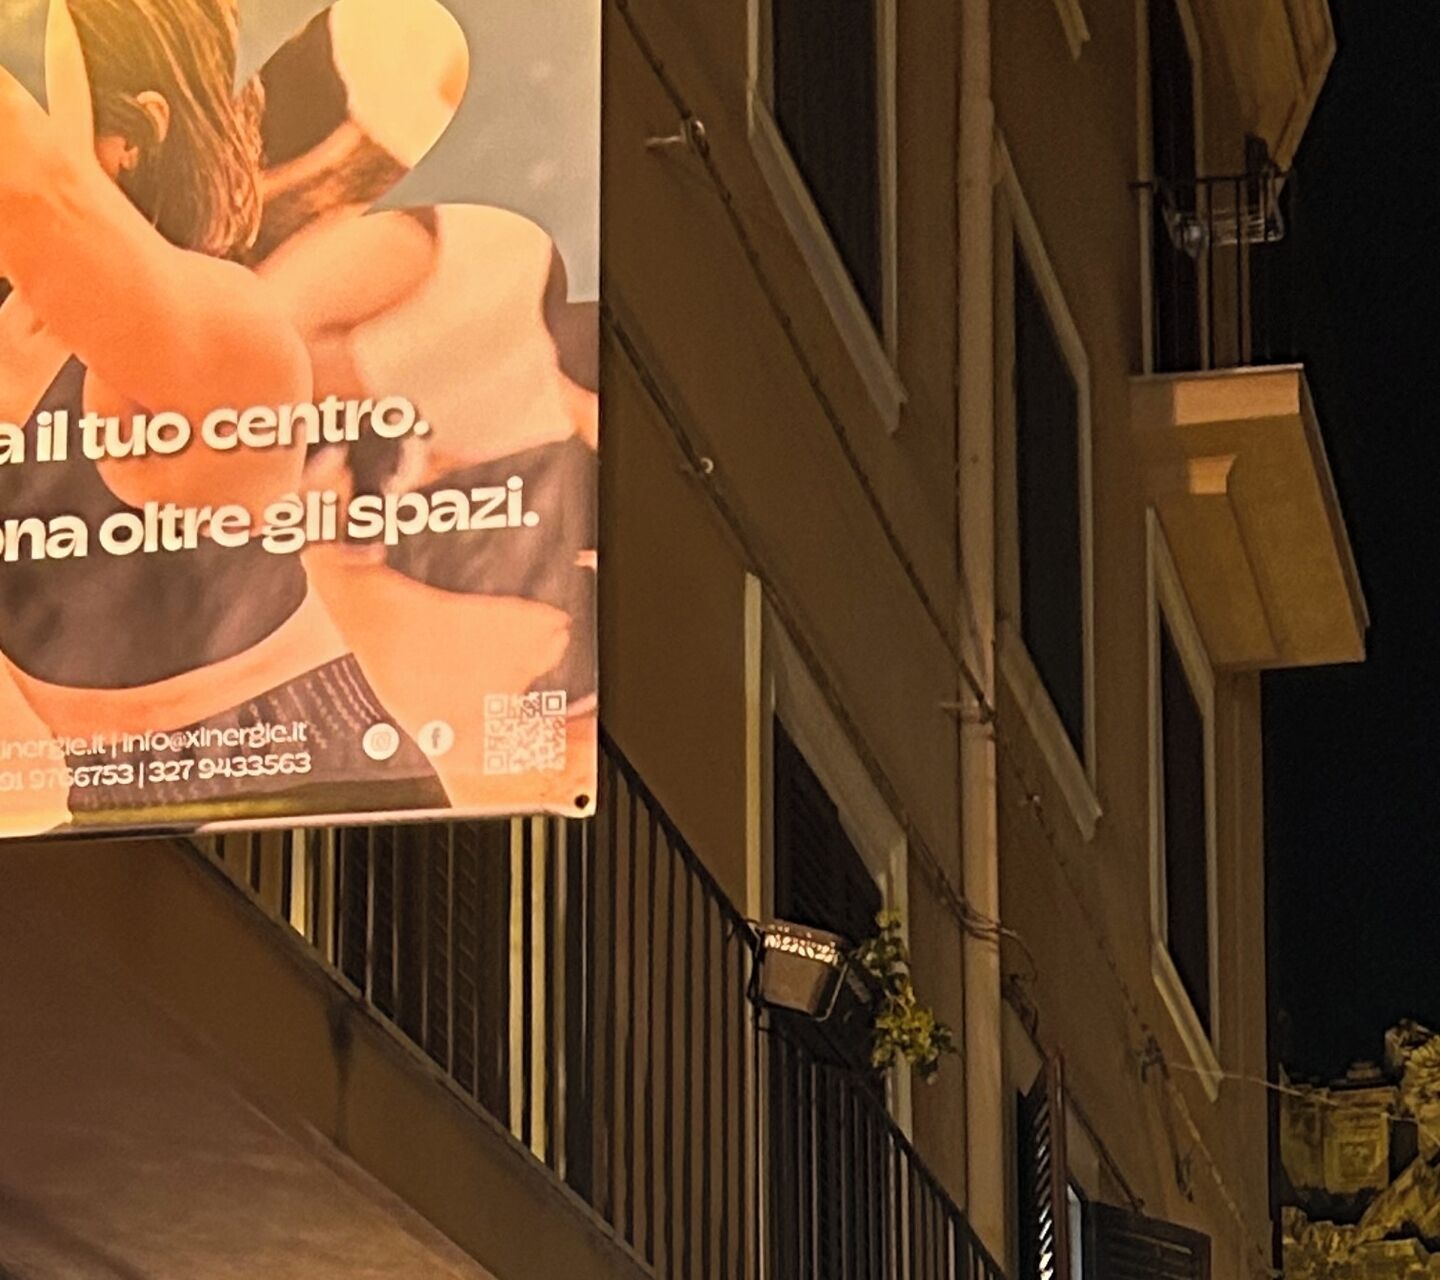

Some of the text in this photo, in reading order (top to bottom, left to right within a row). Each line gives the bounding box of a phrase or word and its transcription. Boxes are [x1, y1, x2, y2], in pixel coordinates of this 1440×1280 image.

[36, 410, 67, 462] il
[79, 411, 190, 457] tuo
[201, 394, 430, 451] centro.
[0, 475, 540, 562] na oltre gli spazi.
[122, 720, 308, 754] info@xinergie.it
[148, 758, 194, 784] 327
[198, 751, 312, 781] 9433563
